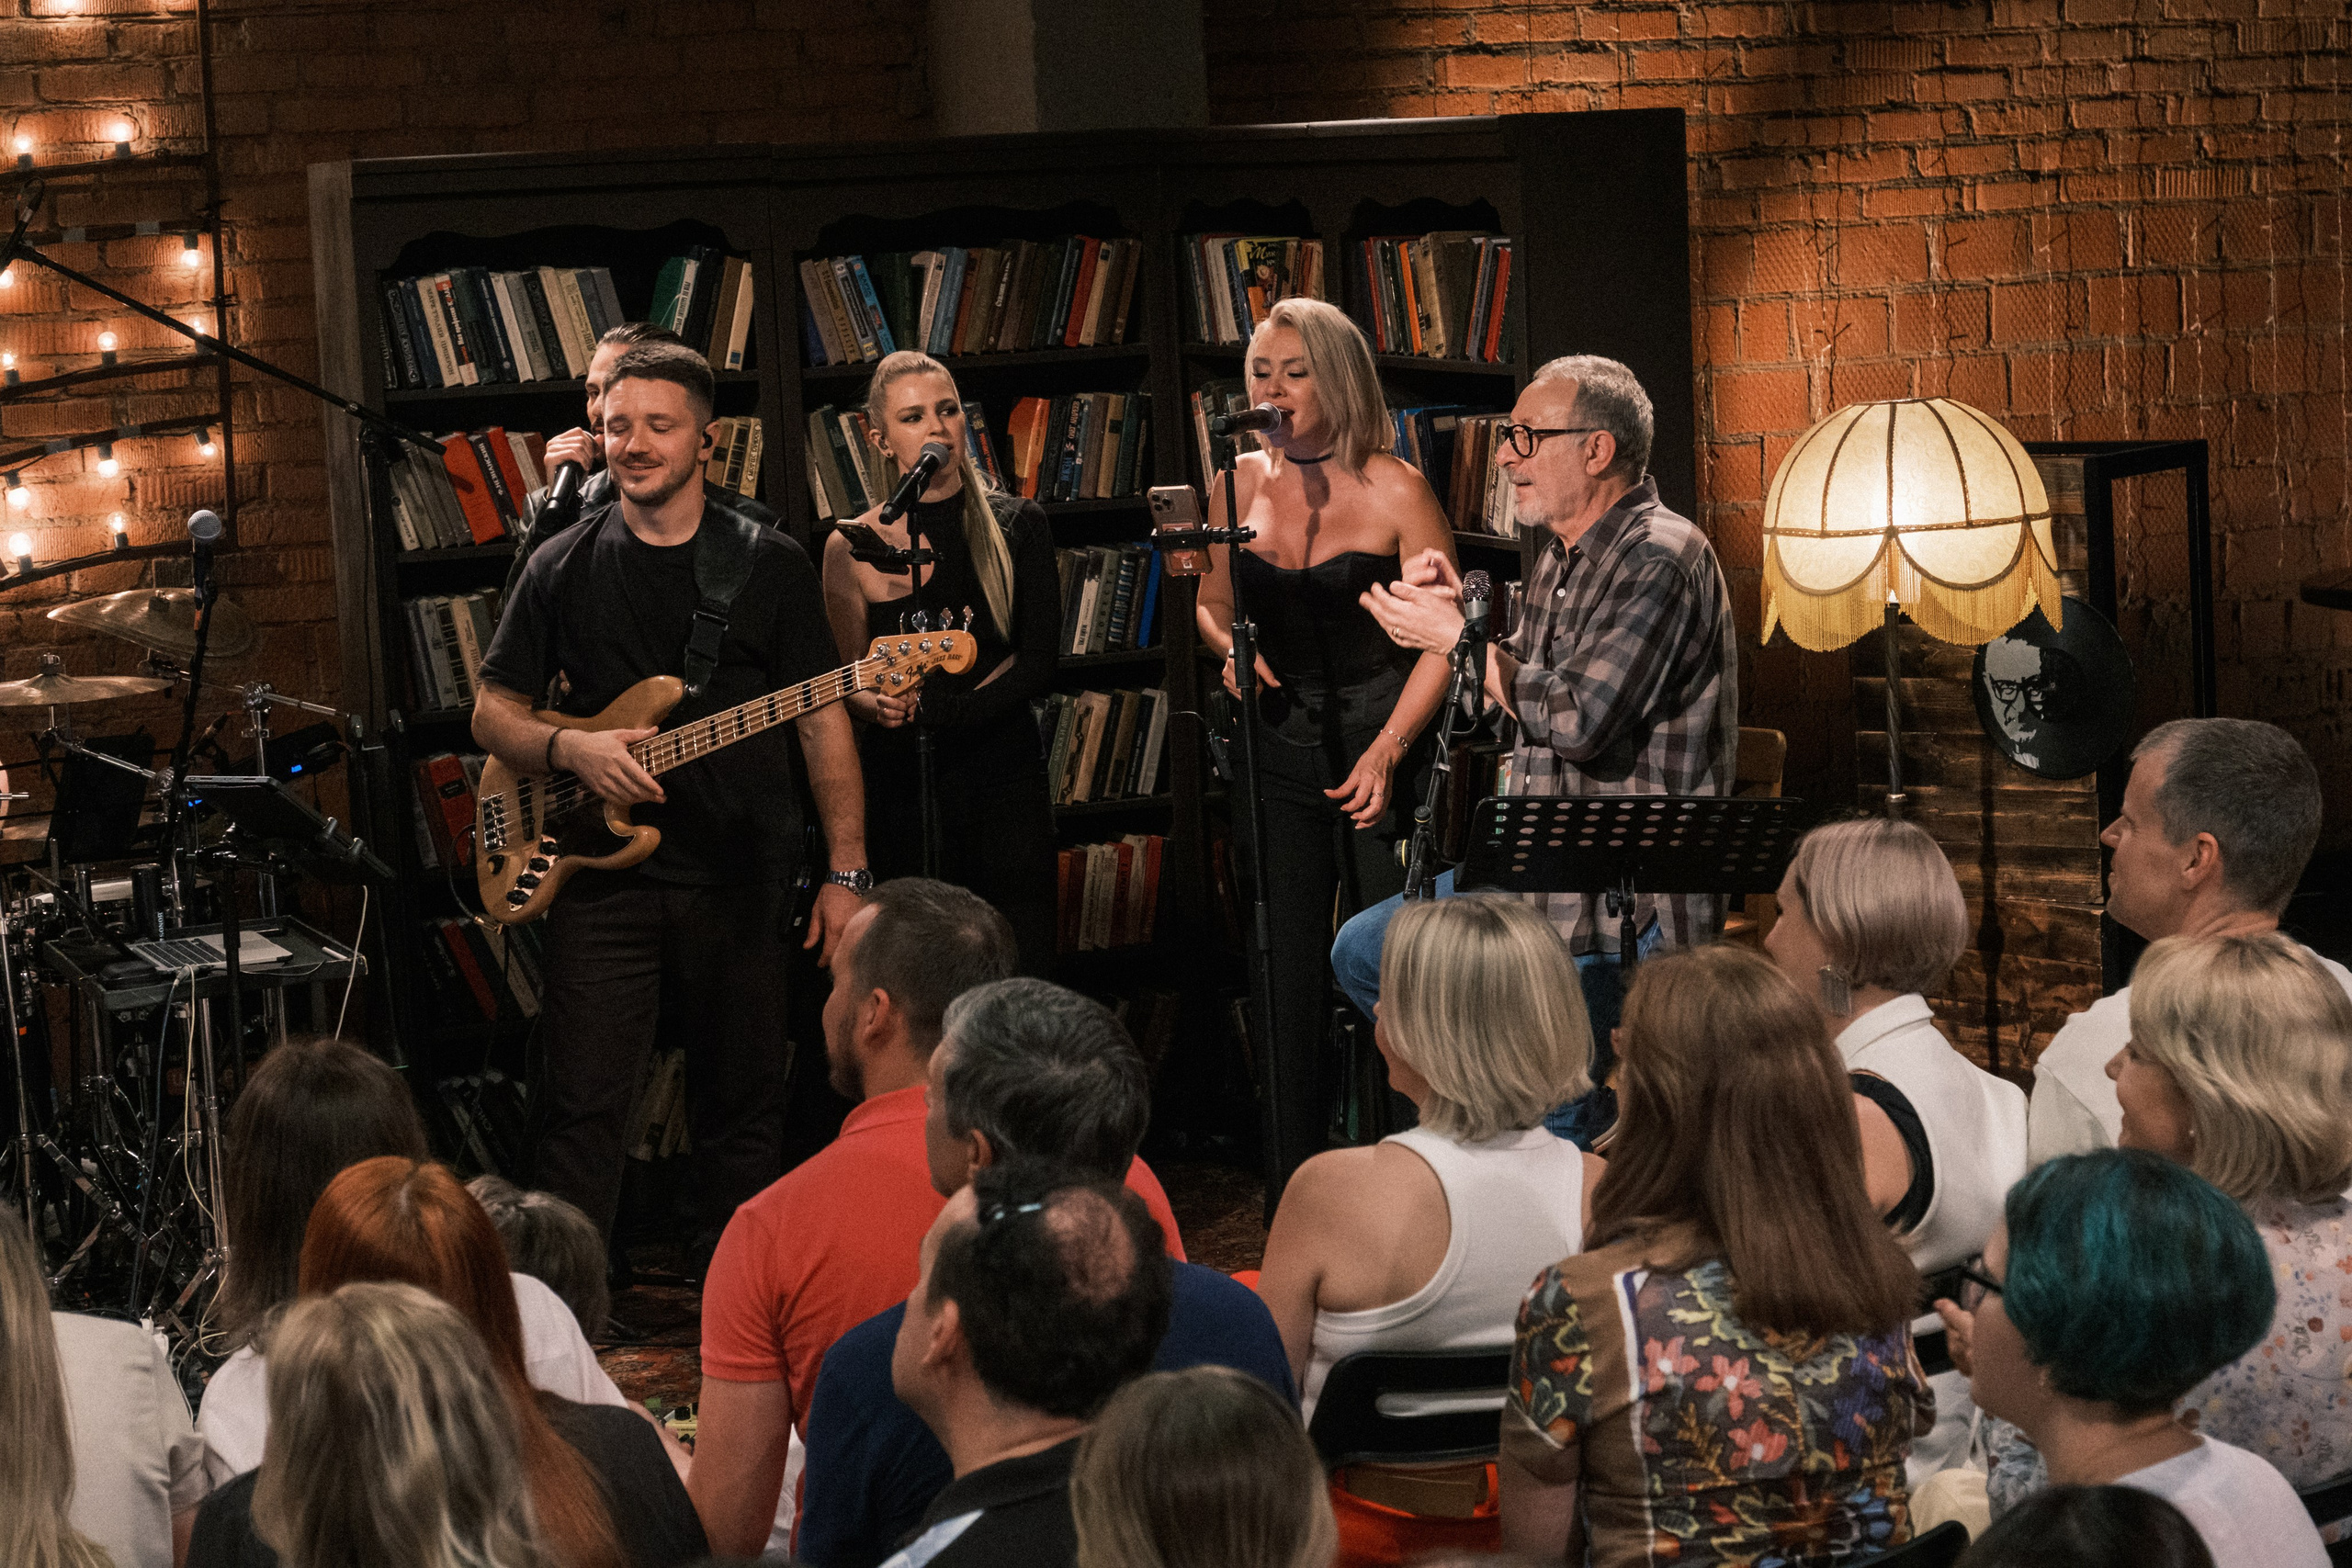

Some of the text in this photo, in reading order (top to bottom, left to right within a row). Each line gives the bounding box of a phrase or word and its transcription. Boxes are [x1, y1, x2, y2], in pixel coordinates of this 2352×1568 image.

[427, 288, 455, 375] МАРК ТУЛЛИЙ ЦИЦЕРОН
[480, 443, 504, 495] Ф.НЕЗНАНСКИЙ
[1097, 569, 1114, 638] ПОВЕСТИ
[932, 655, 945, 663] JAZZ
[1053, 736, 1063, 761] МАСКА
[1060, 706, 1069, 728] ДУША
